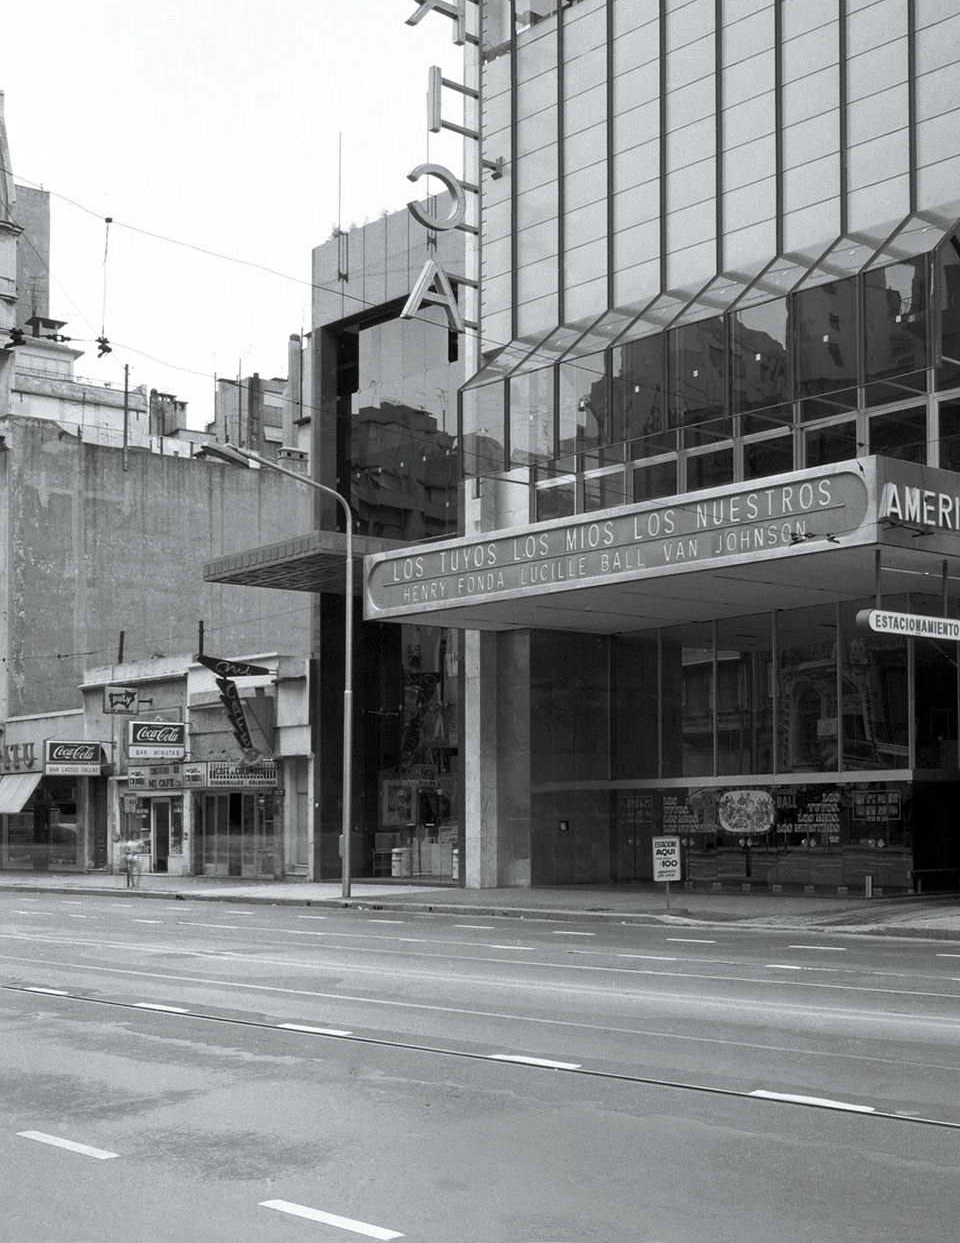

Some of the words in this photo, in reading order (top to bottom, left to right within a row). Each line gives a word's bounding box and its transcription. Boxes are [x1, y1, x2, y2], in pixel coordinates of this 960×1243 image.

[393, 557, 424, 582] LOS
[440, 542, 497, 573] TUYOS
[566, 520, 614, 552] MIOS
[634, 509, 675, 540] LOS
[697, 479, 831, 529] NUESTROS
[403, 581, 447, 603] HENRY
[458, 571, 505, 594] FONDA
[520, 557, 587, 585] LUCILLE
[601, 547, 645, 572] BALL
[663, 538, 698, 562] VAN
[715, 520, 806, 554] JOHNSON
[875, 614, 960, 636] ESTACIONAMIENTO
[655, 848, 676, 856] AQUI
